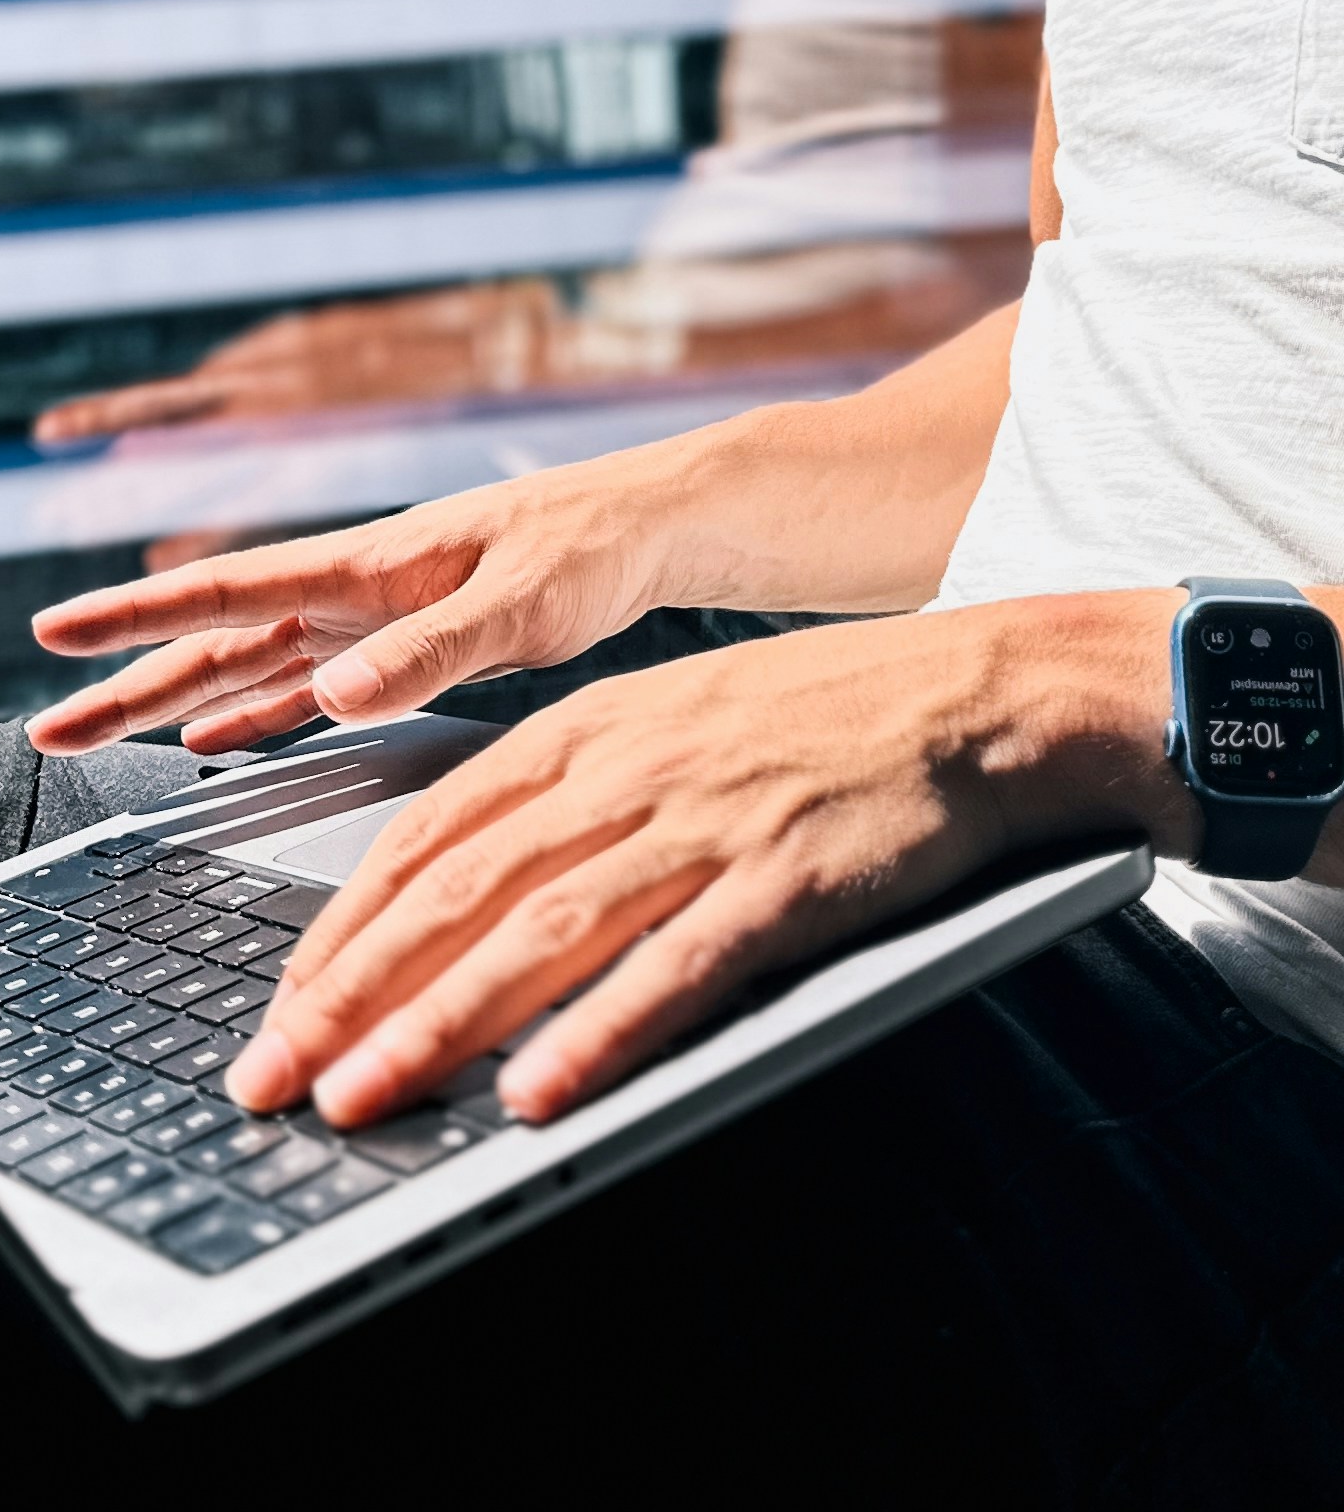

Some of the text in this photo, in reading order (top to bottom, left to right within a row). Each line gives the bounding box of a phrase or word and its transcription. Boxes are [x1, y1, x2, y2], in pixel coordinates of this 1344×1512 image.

[1289, 667, 1314, 679] MTR
[1230, 678, 1300, 693] Gewinnspiel
[1208, 719, 1286, 749] 10:22
[1209, 753, 1227, 765] 25
